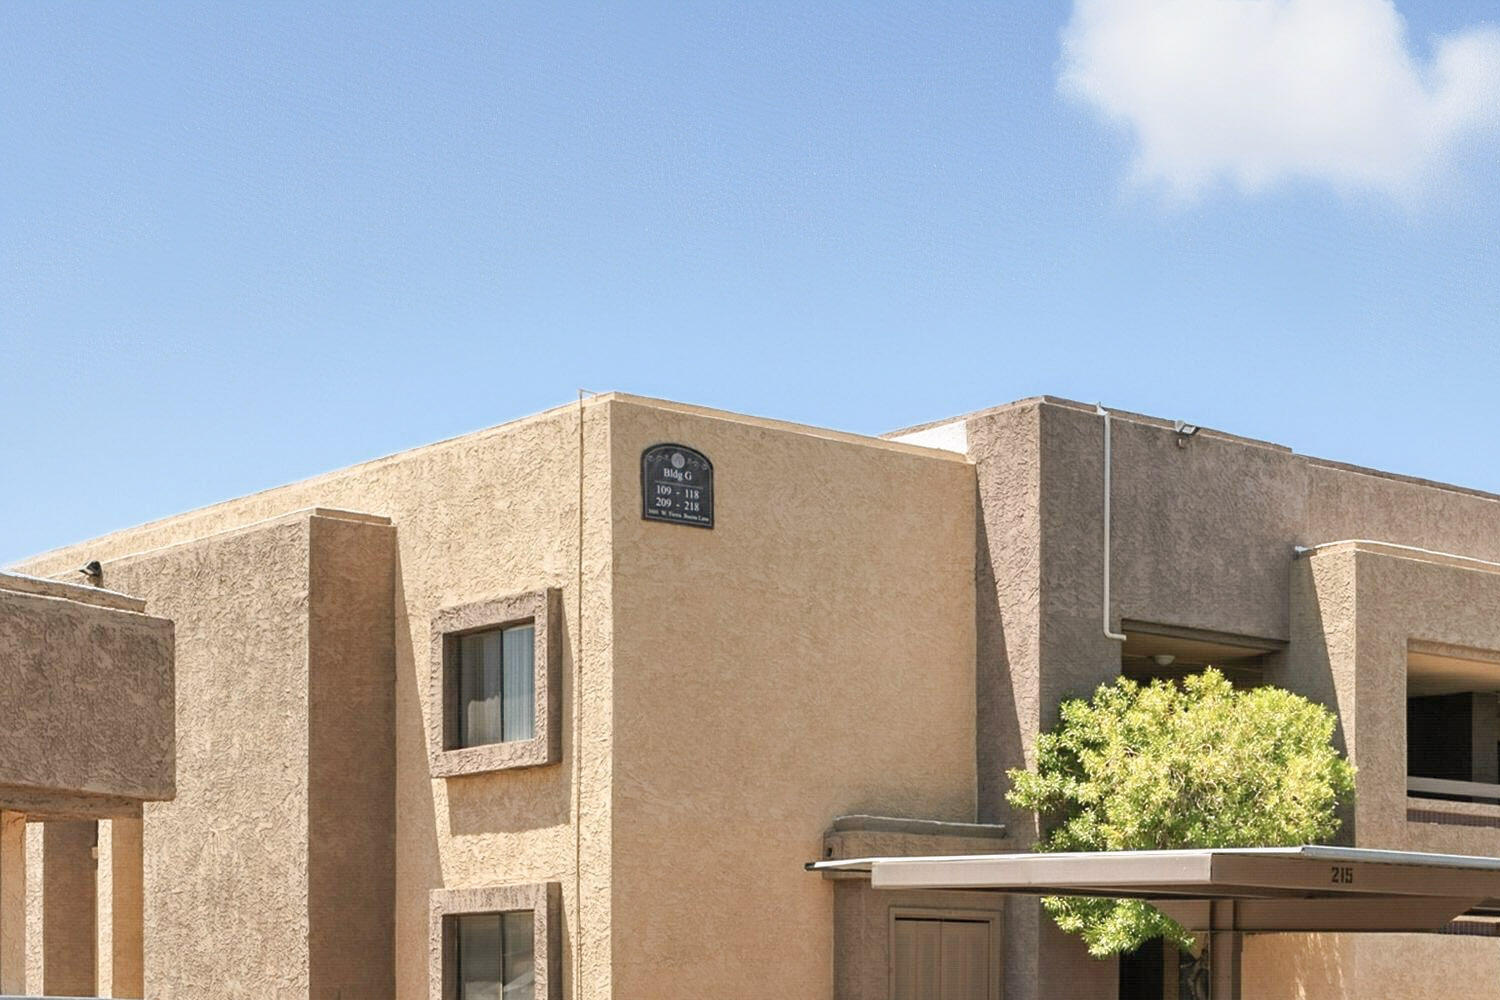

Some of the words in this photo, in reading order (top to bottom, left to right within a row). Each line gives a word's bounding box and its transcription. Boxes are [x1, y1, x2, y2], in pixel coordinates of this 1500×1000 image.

[664, 468, 683, 481] Bldg
[684, 471, 692, 480] G
[656, 485, 672, 495] 109
[685, 489, 700, 499] 118
[655, 497, 672, 507] 209
[684, 501, 700, 511] 218
[1331, 866, 1353, 884] 215
